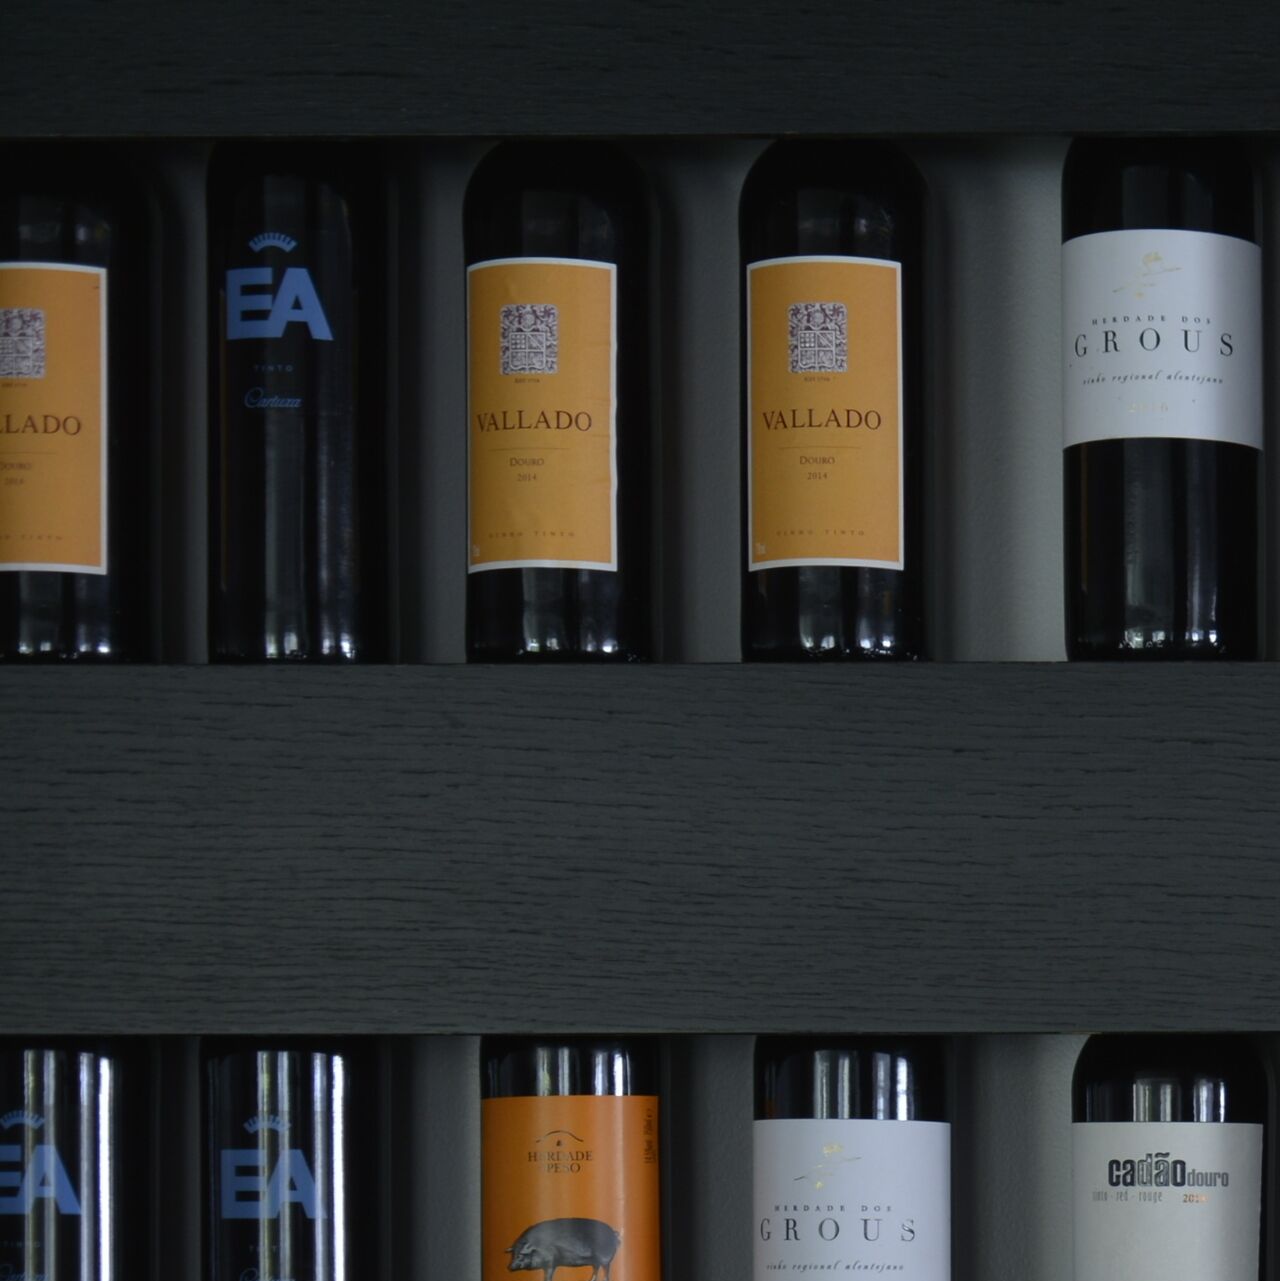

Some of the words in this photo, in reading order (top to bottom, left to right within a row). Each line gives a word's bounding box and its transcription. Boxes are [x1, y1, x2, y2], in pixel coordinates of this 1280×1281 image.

[227, 267, 334, 341] EA
[1092, 317, 1166, 326] HERDADE
[1182, 317, 1212, 325] DOS
[1074, 328, 1234, 358] GROUS
[0, 414, 82, 436] LADO
[476, 410, 593, 433] VALLADO
[762, 409, 882, 431] VALLADO
[509, 457, 545, 468] DOURO
[800, 456, 836, 466] DOURO
[1108, 1152, 1186, 1188] cadão
[1187, 1168, 1230, 1188] douro
[221, 1148, 328, 1220] EA
[774, 1204, 846, 1212] HERDADE
[760, 1217, 916, 1242] GROUS
